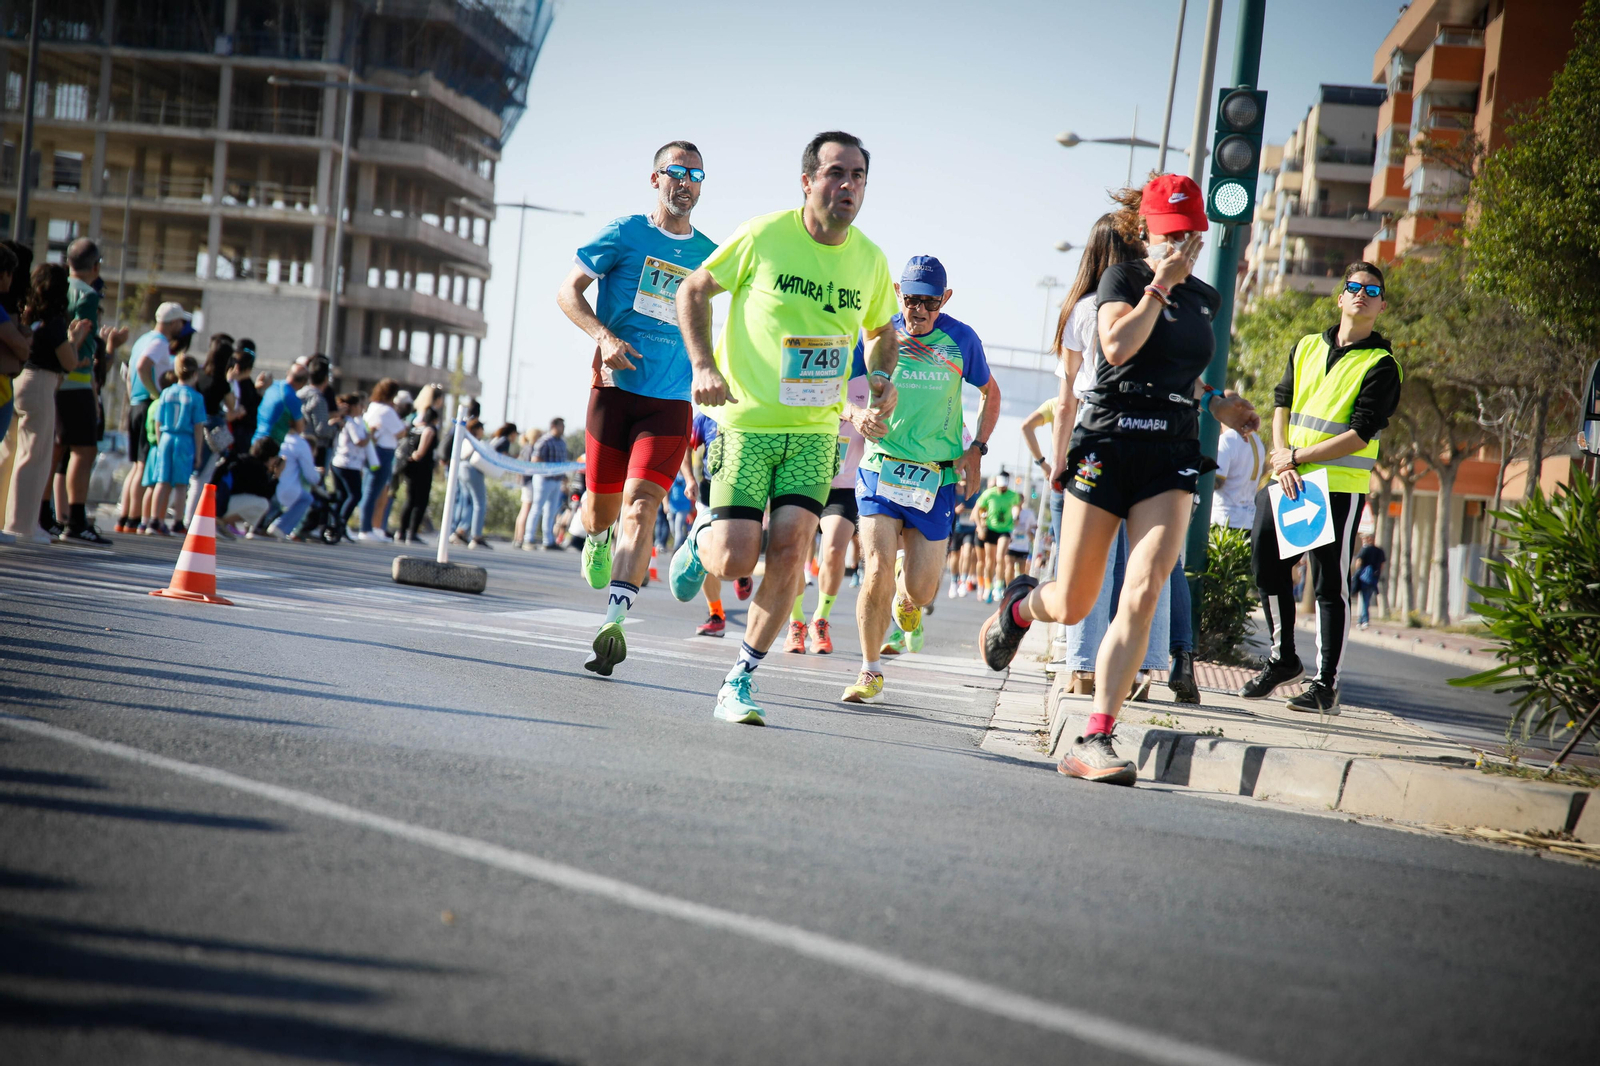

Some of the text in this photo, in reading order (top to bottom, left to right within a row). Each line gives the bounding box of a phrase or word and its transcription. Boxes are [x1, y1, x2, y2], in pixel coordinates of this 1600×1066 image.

[773, 273, 861, 311] NATURA BIKE
[799, 348, 840, 369] 748
[815, 369, 837, 377] MONTES
[901, 369, 951, 381] SAKATA
[1117, 417, 1168, 431] KAMUABU
[892, 463, 931, 483] 477
